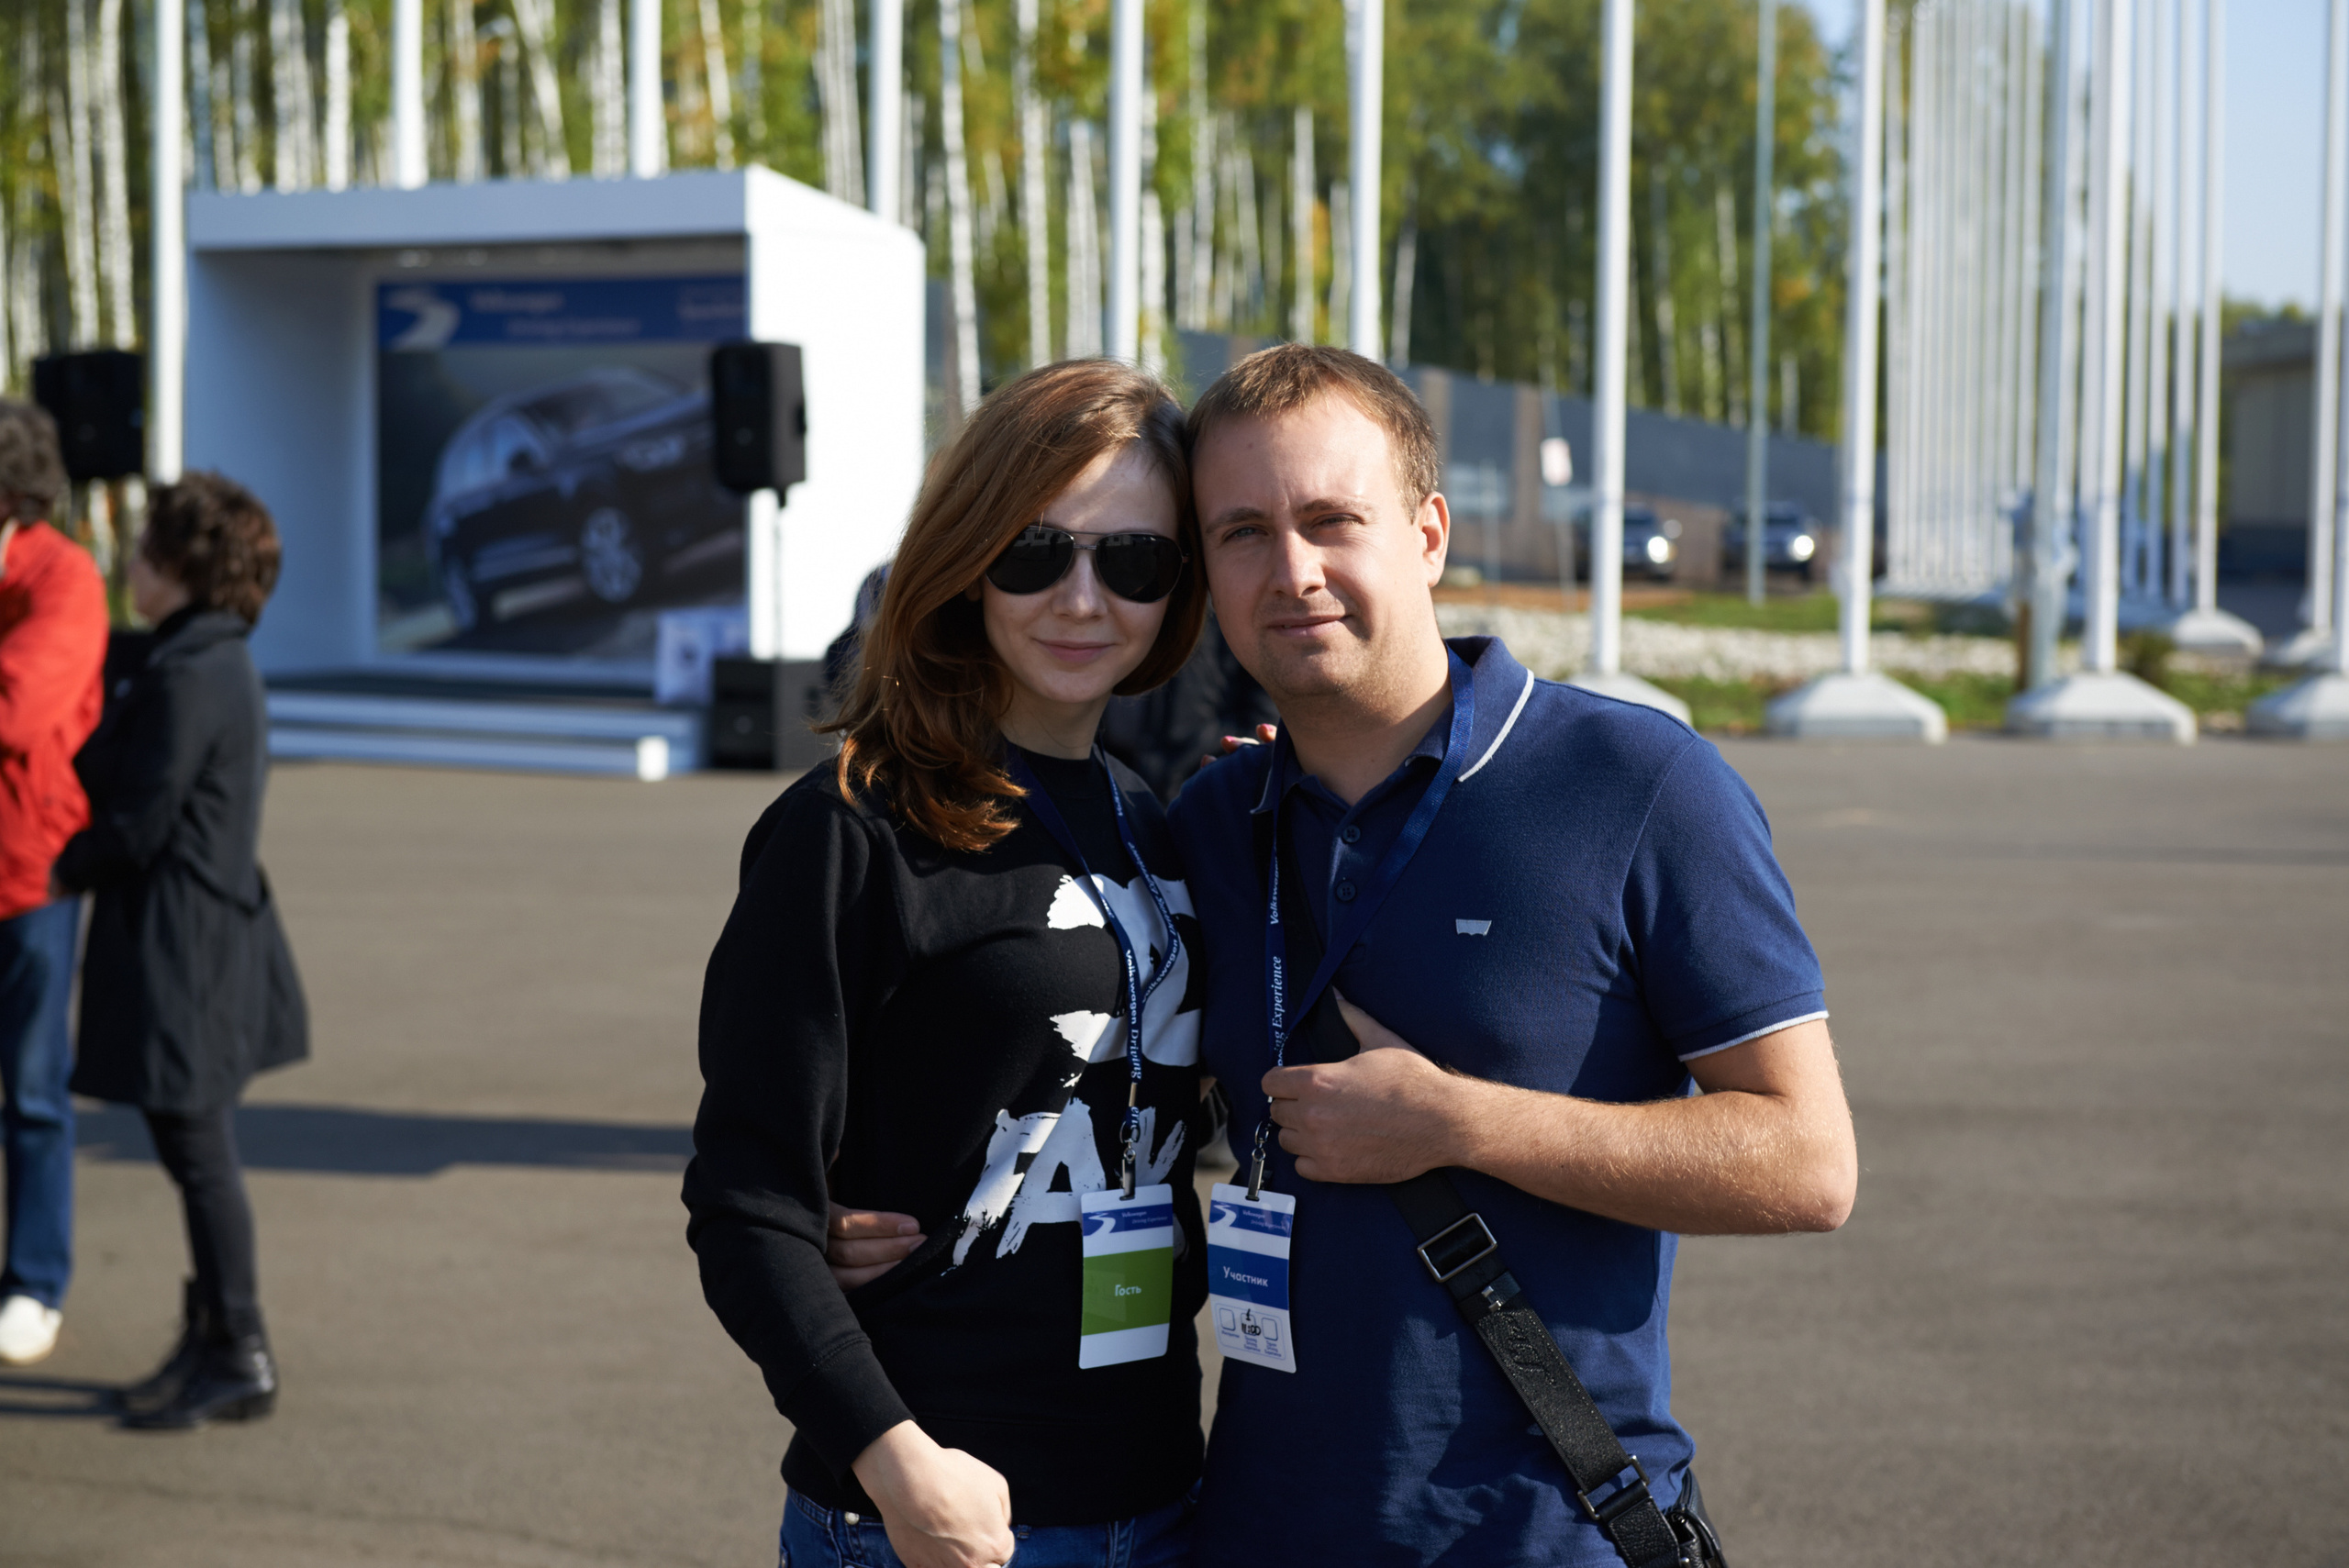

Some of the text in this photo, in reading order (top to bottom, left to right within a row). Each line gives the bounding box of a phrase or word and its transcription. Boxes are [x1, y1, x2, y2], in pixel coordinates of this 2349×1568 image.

[1126, 949, 1142, 1080] Volkswagen Driving
[1271, 955, 1286, 1029] Experience
[1114, 1284, 1142, 1297] Гость
[1223, 1266, 1269, 1287] Участник
